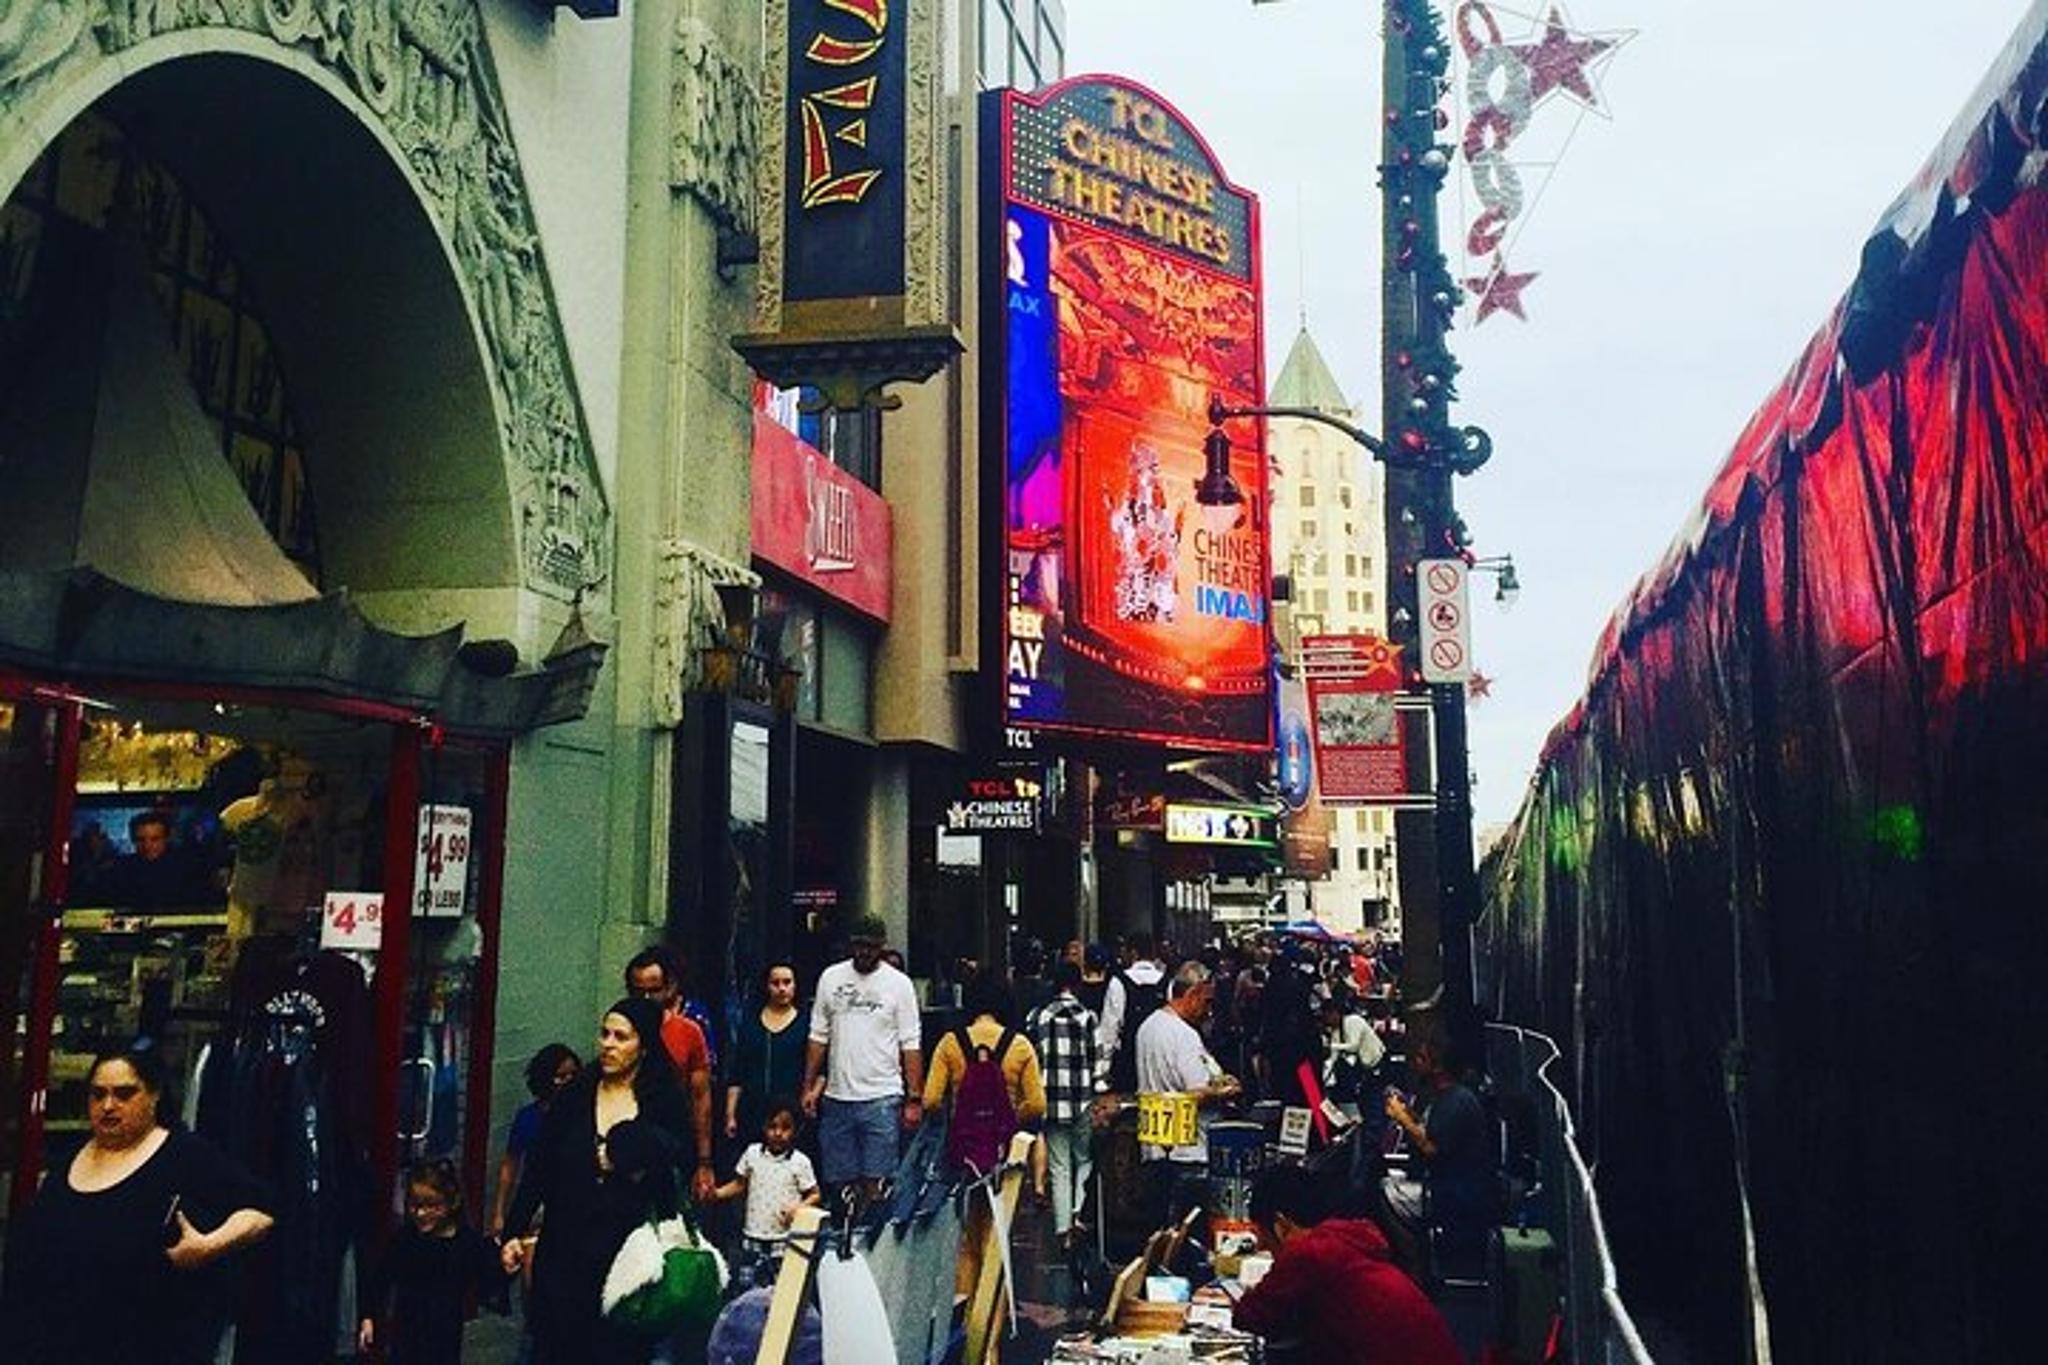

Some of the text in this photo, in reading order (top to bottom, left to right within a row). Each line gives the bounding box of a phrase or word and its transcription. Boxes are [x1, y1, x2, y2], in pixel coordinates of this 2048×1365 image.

[1107, 87, 1176, 147] TCL
[1060, 115, 1217, 211] CHINESE
[1047, 155, 1233, 265] THEATRES
[1008, 639, 1042, 680] AY
[1005, 728, 1033, 748] TCL
[968, 781, 1011, 797] TCL
[967, 801, 1031, 815] CHINESE
[969, 815, 1033, 828] THEATRES
